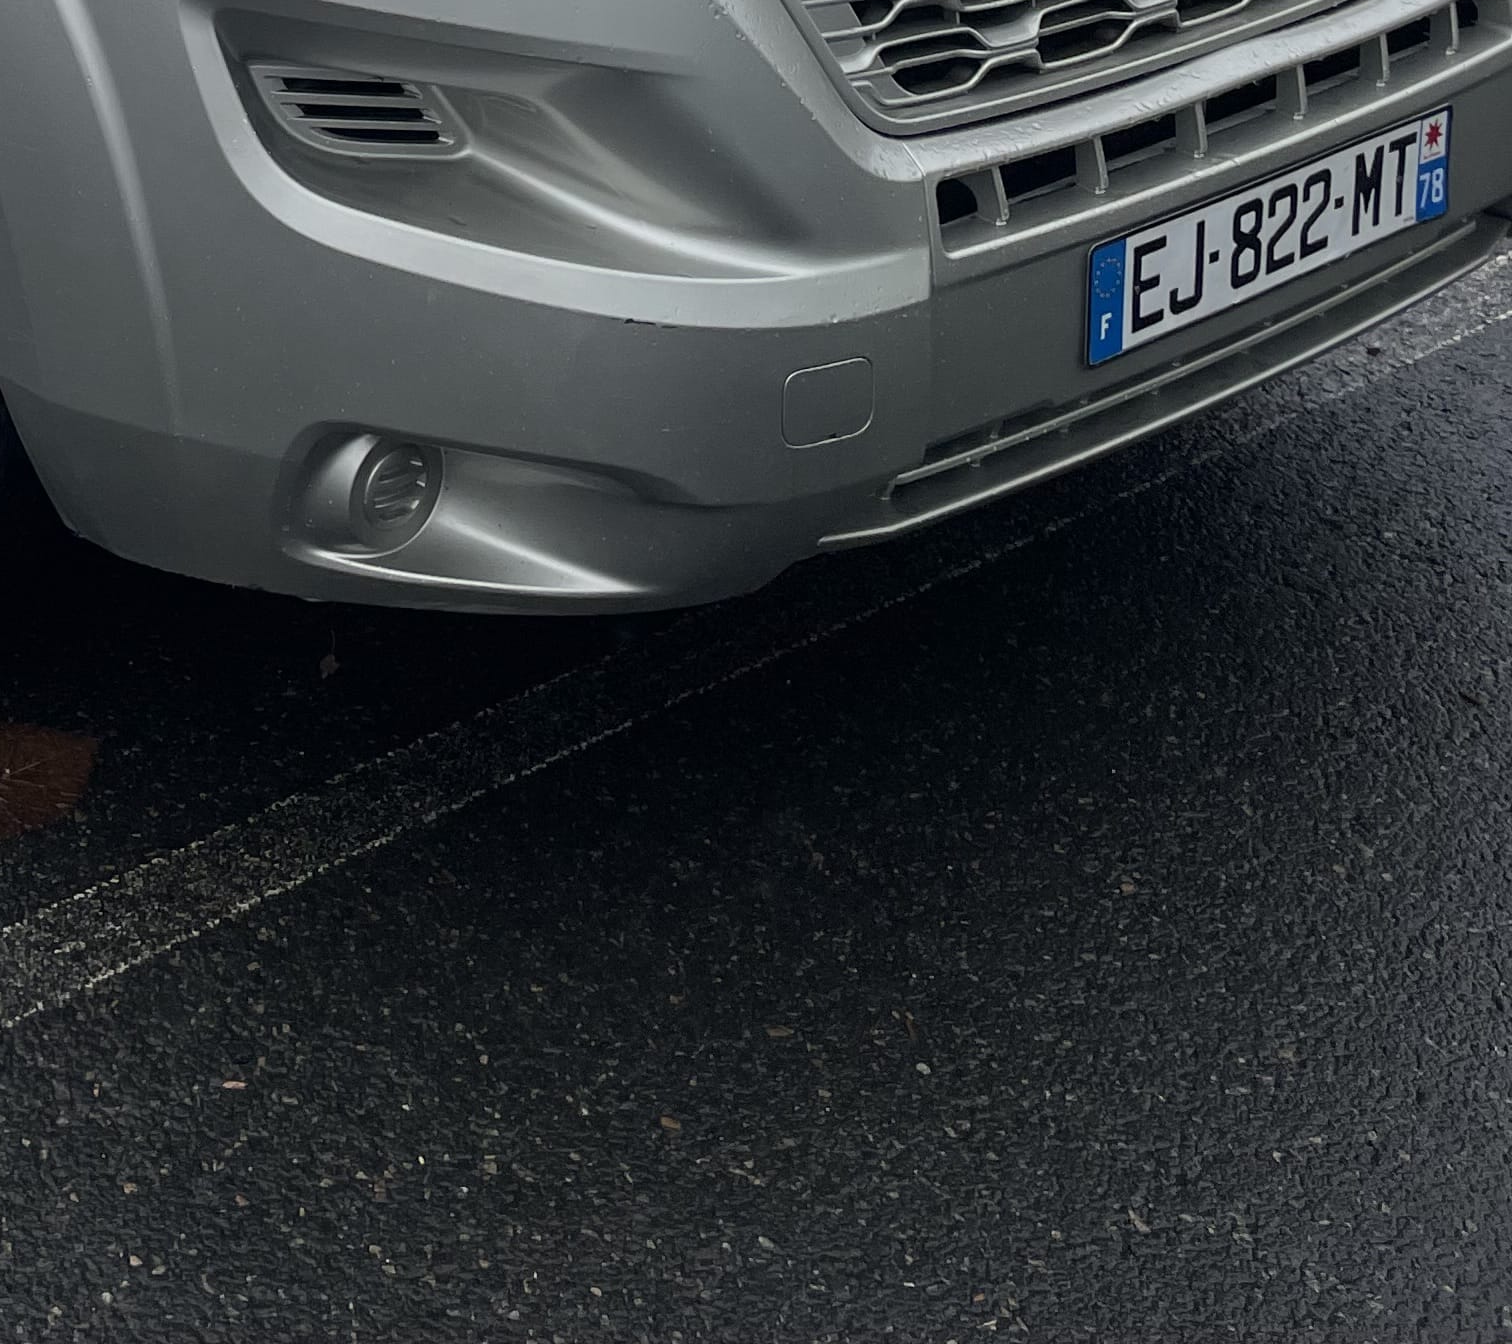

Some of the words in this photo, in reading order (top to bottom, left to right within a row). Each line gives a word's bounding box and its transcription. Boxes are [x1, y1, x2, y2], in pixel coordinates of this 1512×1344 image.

[1419, 167, 1444, 209] 78
[1131, 131, 1417, 333] EJ-822-MT
[1100, 312, 1113, 340] F
